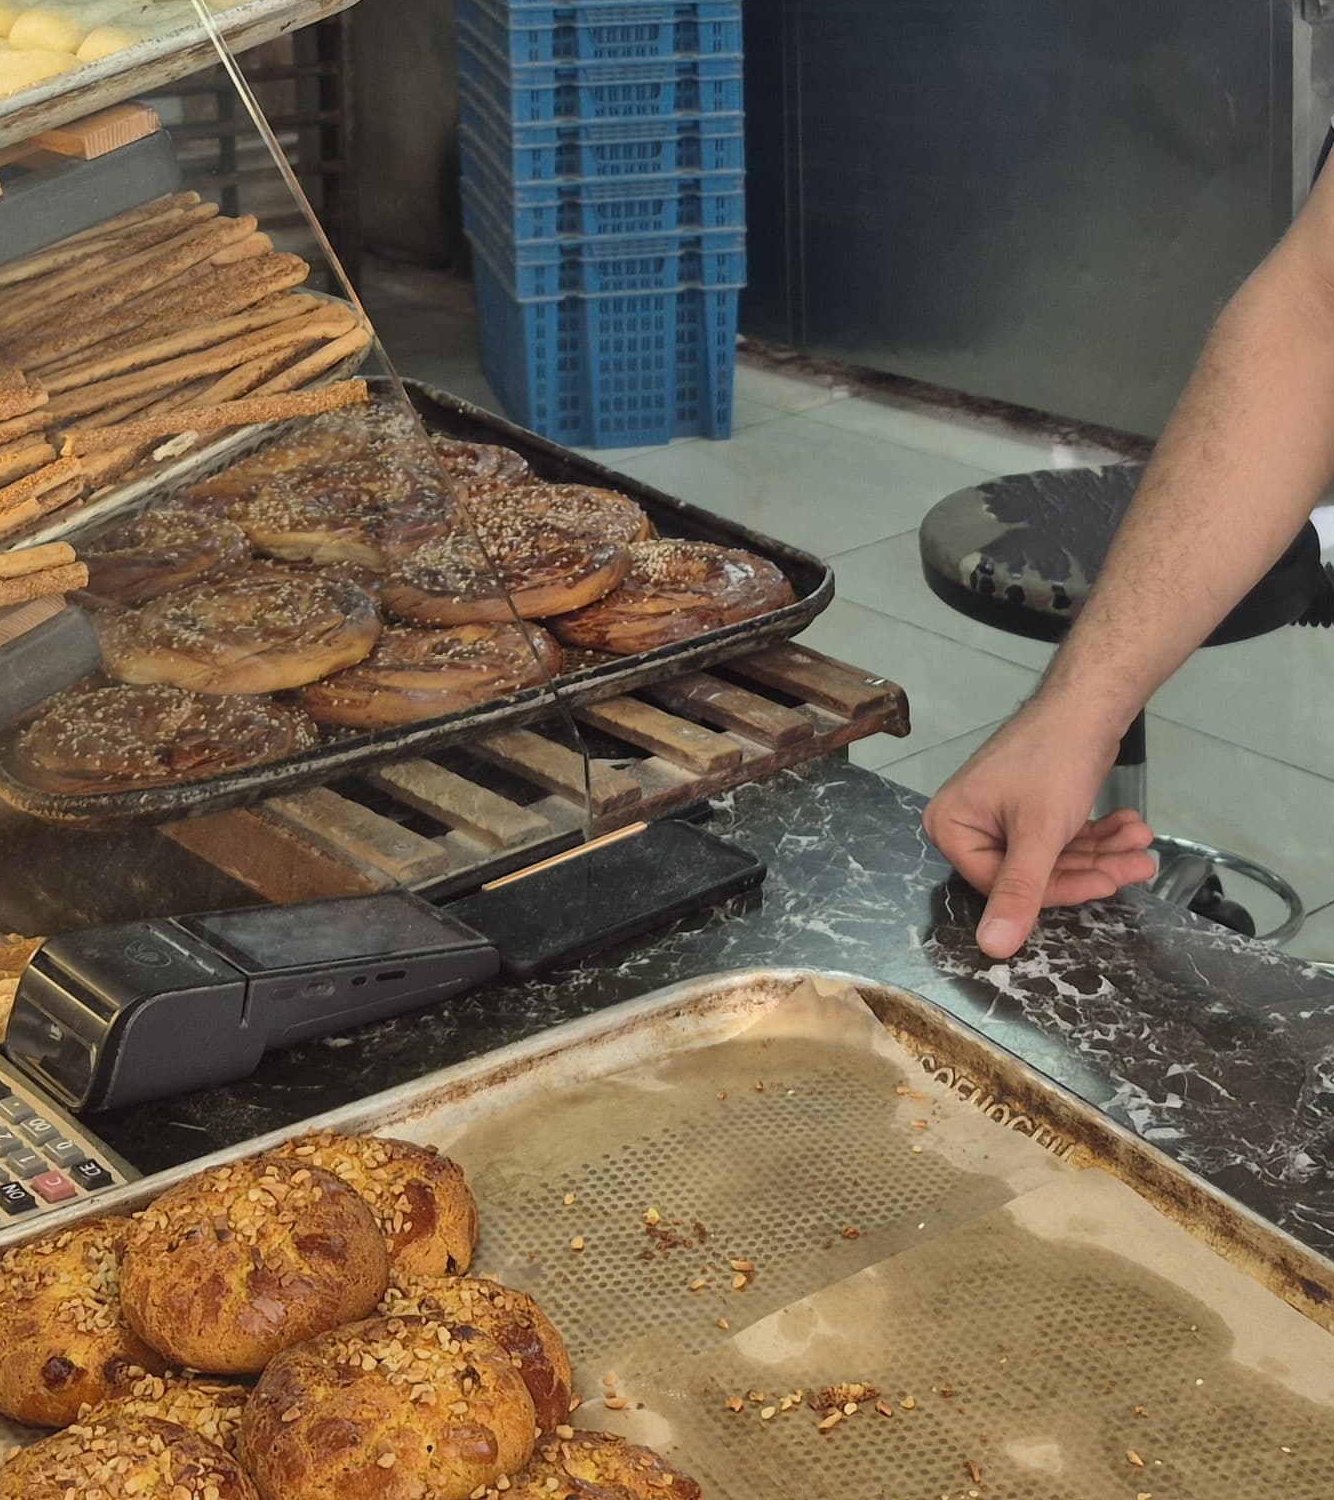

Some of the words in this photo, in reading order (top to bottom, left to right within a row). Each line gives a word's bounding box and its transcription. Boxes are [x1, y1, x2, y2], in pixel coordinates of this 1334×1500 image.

[29, 1118, 52, 1131] 00
[19, 1155, 36, 1163] 1
[79, 1162, 101, 1176] CE
[2, 1183, 26, 1199] ON
